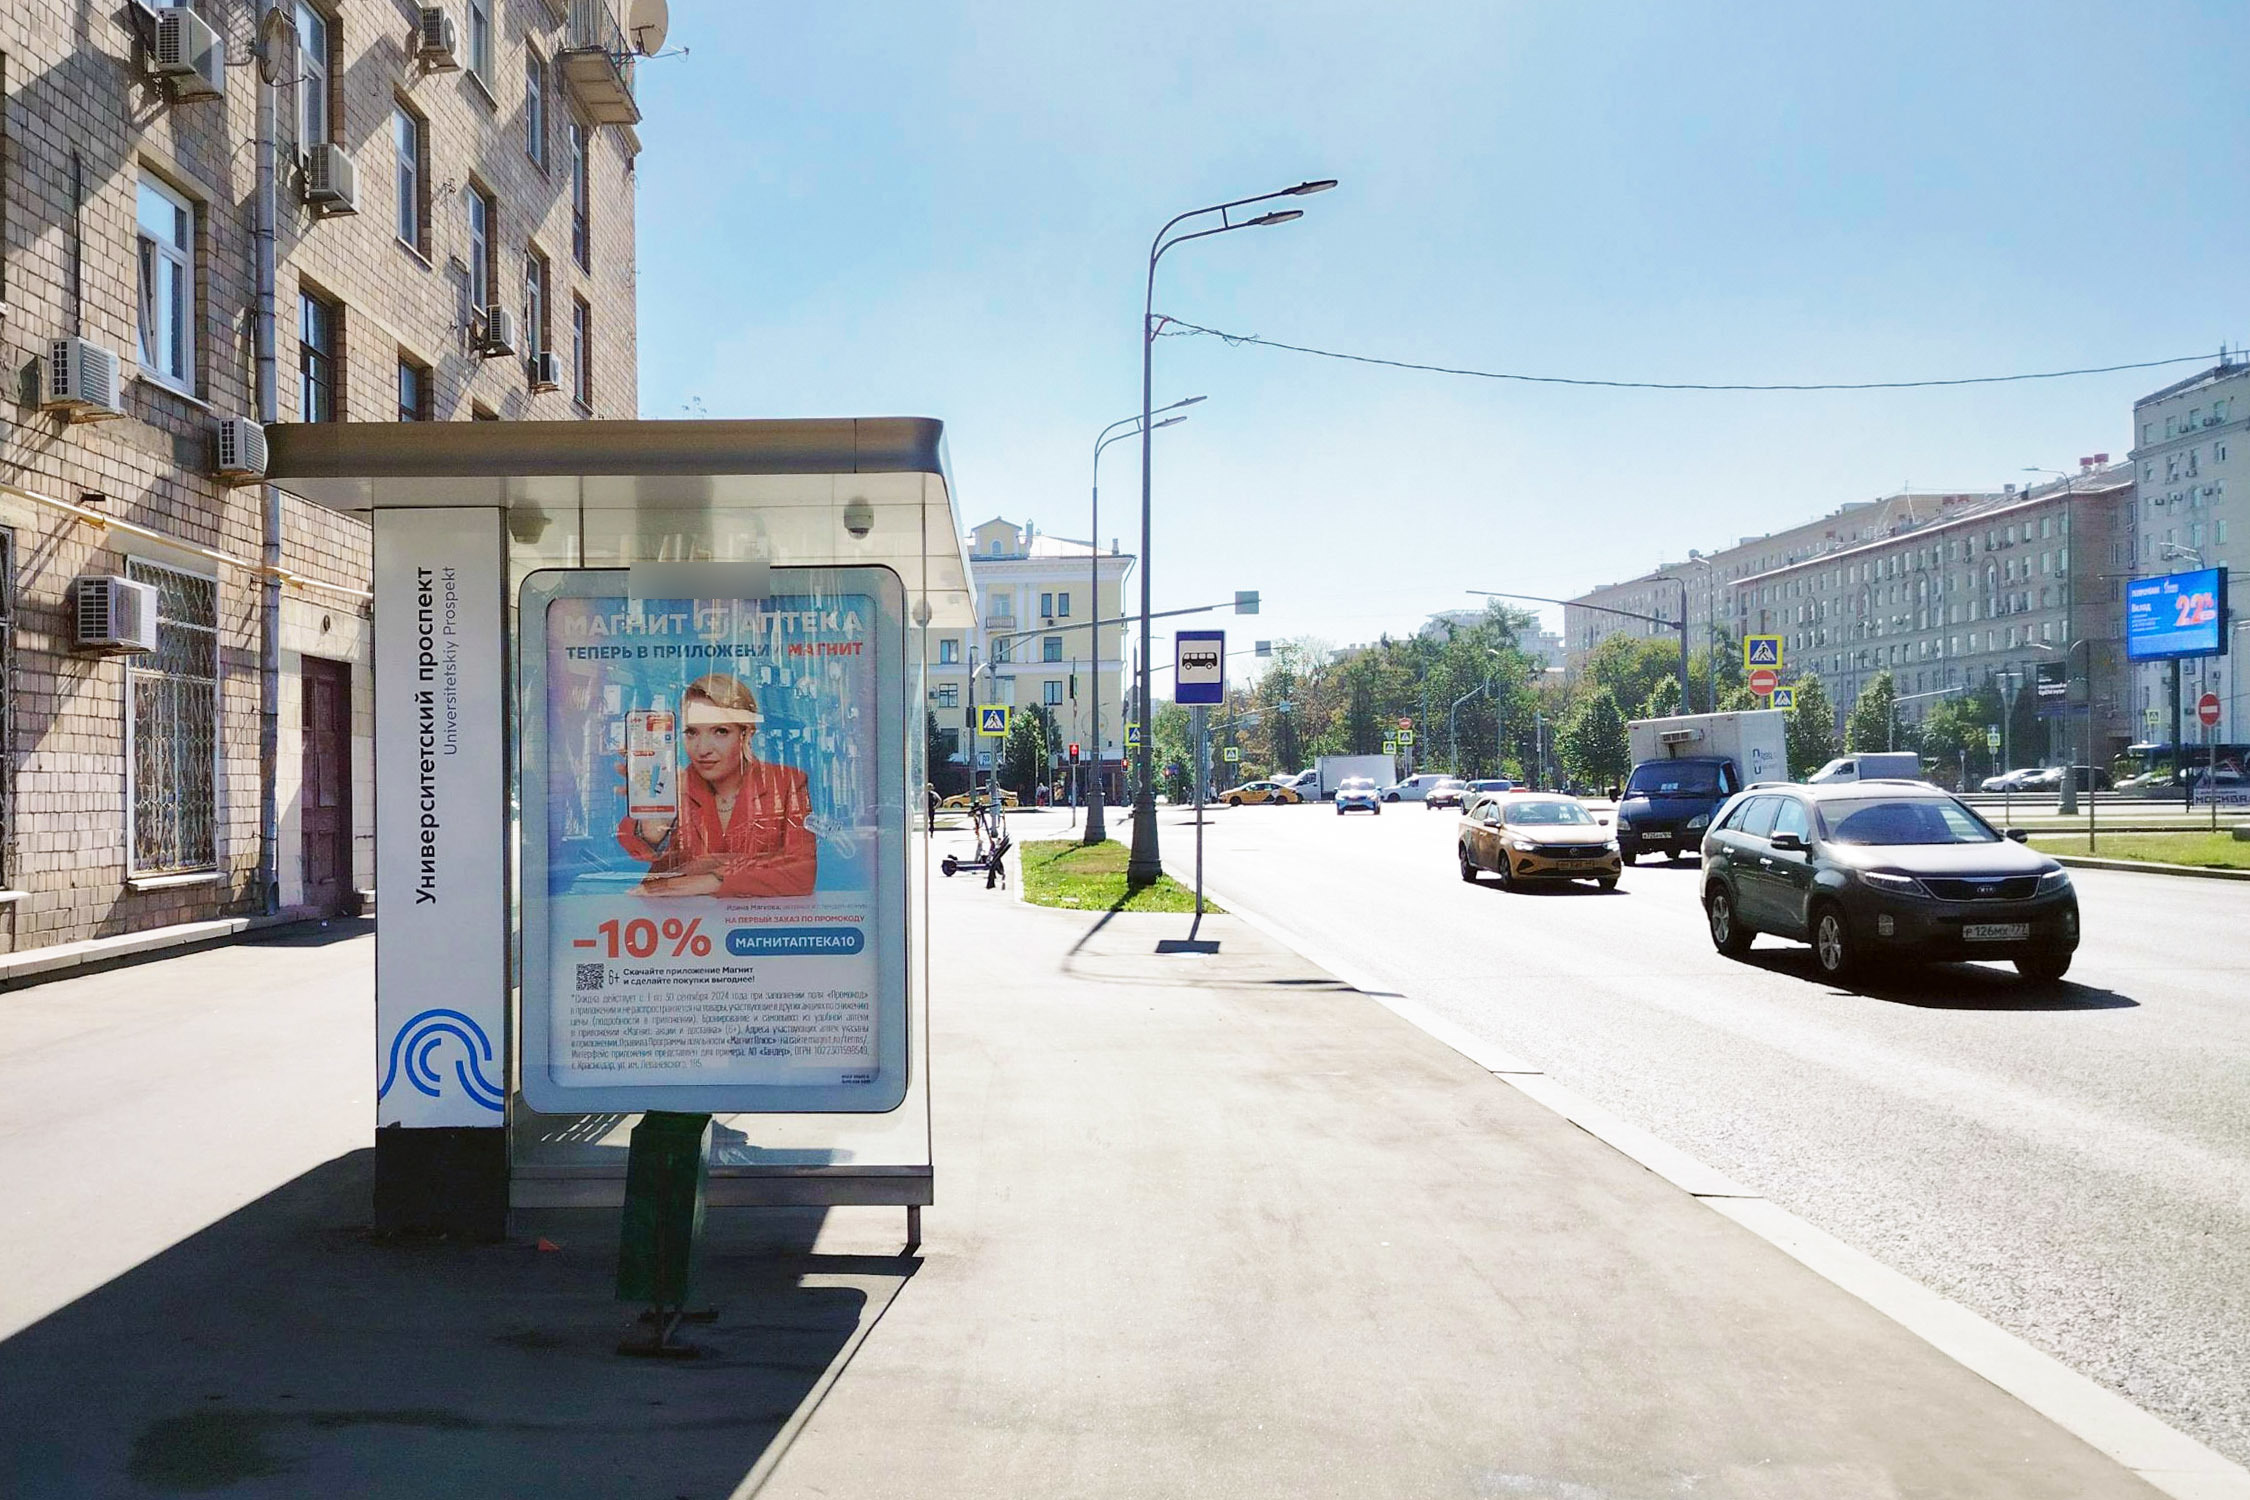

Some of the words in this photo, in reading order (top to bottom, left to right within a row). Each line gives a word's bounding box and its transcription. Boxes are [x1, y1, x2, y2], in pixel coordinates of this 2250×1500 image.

[441, 567, 458, 635] Prospekt
[418, 567, 438, 681] проспект
[564, 613, 688, 636] МАГНИТ
[740, 610, 864, 634] АПТЕКА
[566, 645, 632, 660] ТЕПЕРЬ
[637, 644, 648, 659] В
[788, 642, 863, 657] МАГНИТ
[442, 641, 459, 755] Universitetskiy
[415, 691, 439, 904] Университетский
[801, 914, 812, 922] ПО
[814, 914, 865, 923] ПРОМОКОДУ
[735, 936, 855, 948] МАГНИТАПТЕКА10
[608, 969, 620, 985] 6+
[623, 968, 664, 976] Скачайте
[665, 968, 720, 977] приложение
[722, 966, 753, 974] Магнит
[631, 978, 671, 986] сделайте
[672, 977, 709, 985] покупки
[711, 975, 755, 984] выгоднее!
